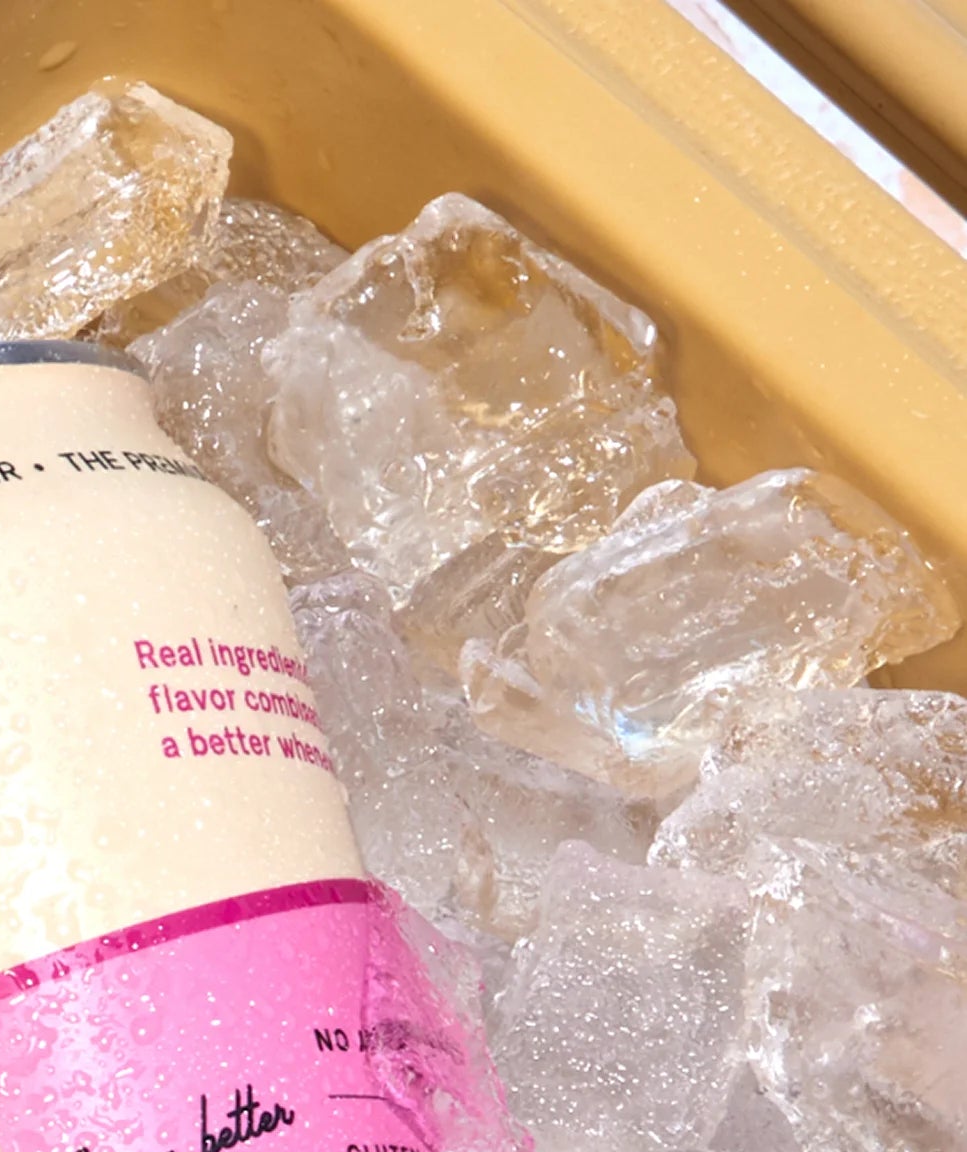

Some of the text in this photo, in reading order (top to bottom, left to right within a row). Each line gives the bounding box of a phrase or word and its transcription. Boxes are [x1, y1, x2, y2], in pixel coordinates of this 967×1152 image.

[58, 450, 125, 473] THE
[133, 637, 203, 669] Real
[148, 683, 236, 714] flavor
[161, 735, 182, 758] a
[187, 726, 271, 758] better
[313, 1028, 350, 1052] NO
